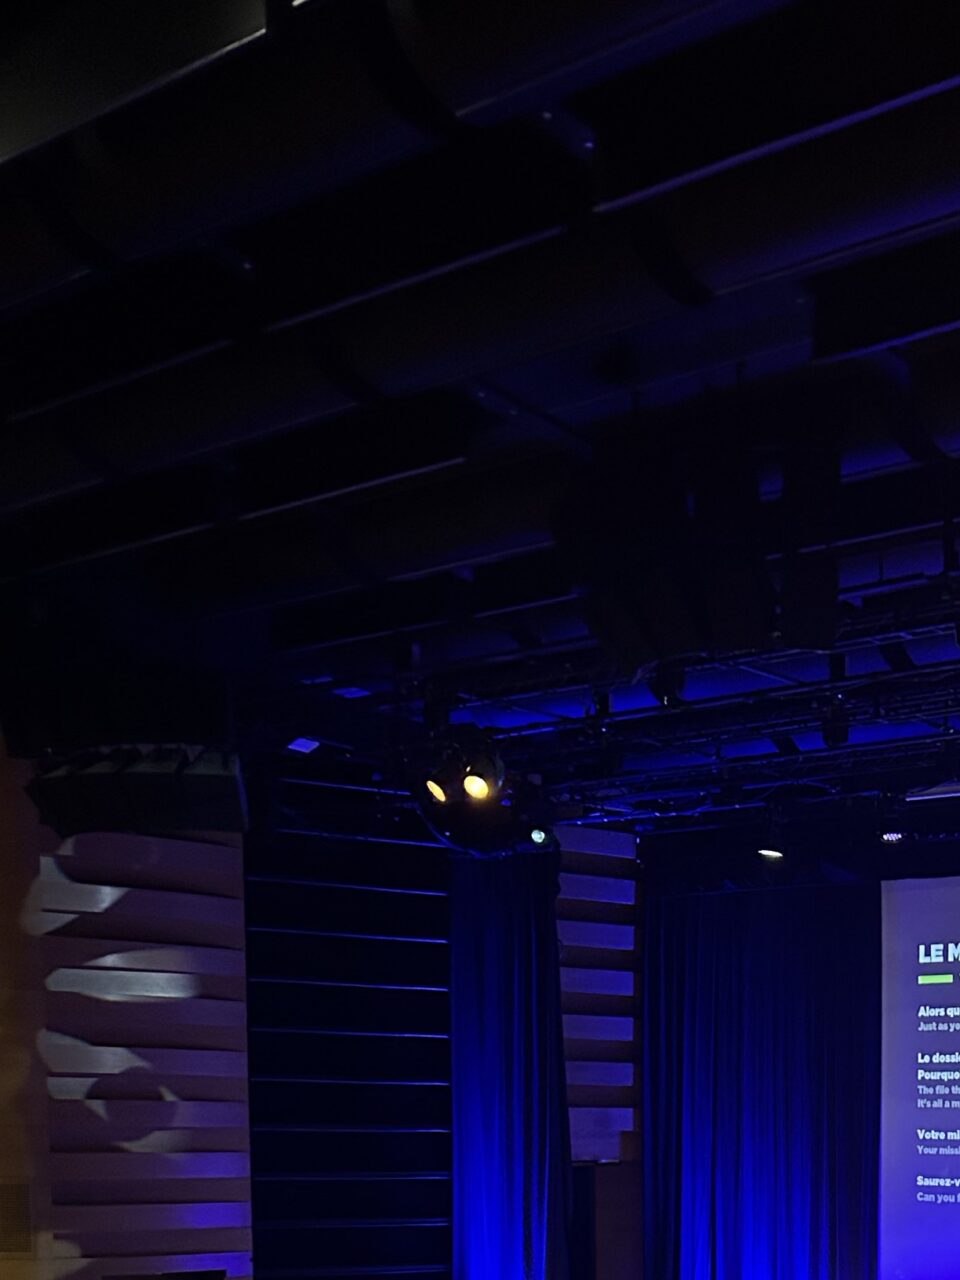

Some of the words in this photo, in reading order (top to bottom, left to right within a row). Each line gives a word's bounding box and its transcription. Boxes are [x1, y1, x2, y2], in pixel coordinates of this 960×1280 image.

[919, 944, 943, 963] LE
[918, 1006, 945, 1017] Alors
[918, 1021, 937, 1031] Just
[918, 1053, 929, 1063] Le
[918, 1085, 934, 1094] The
[936, 1085, 949, 1094] file
[932, 1099, 942, 1108] all
[918, 1129, 945, 1140] Votre
[918, 1146, 937, 1155] Your
[917, 1193, 934, 1202] Can
[935, 1195, 956, 1205] you
